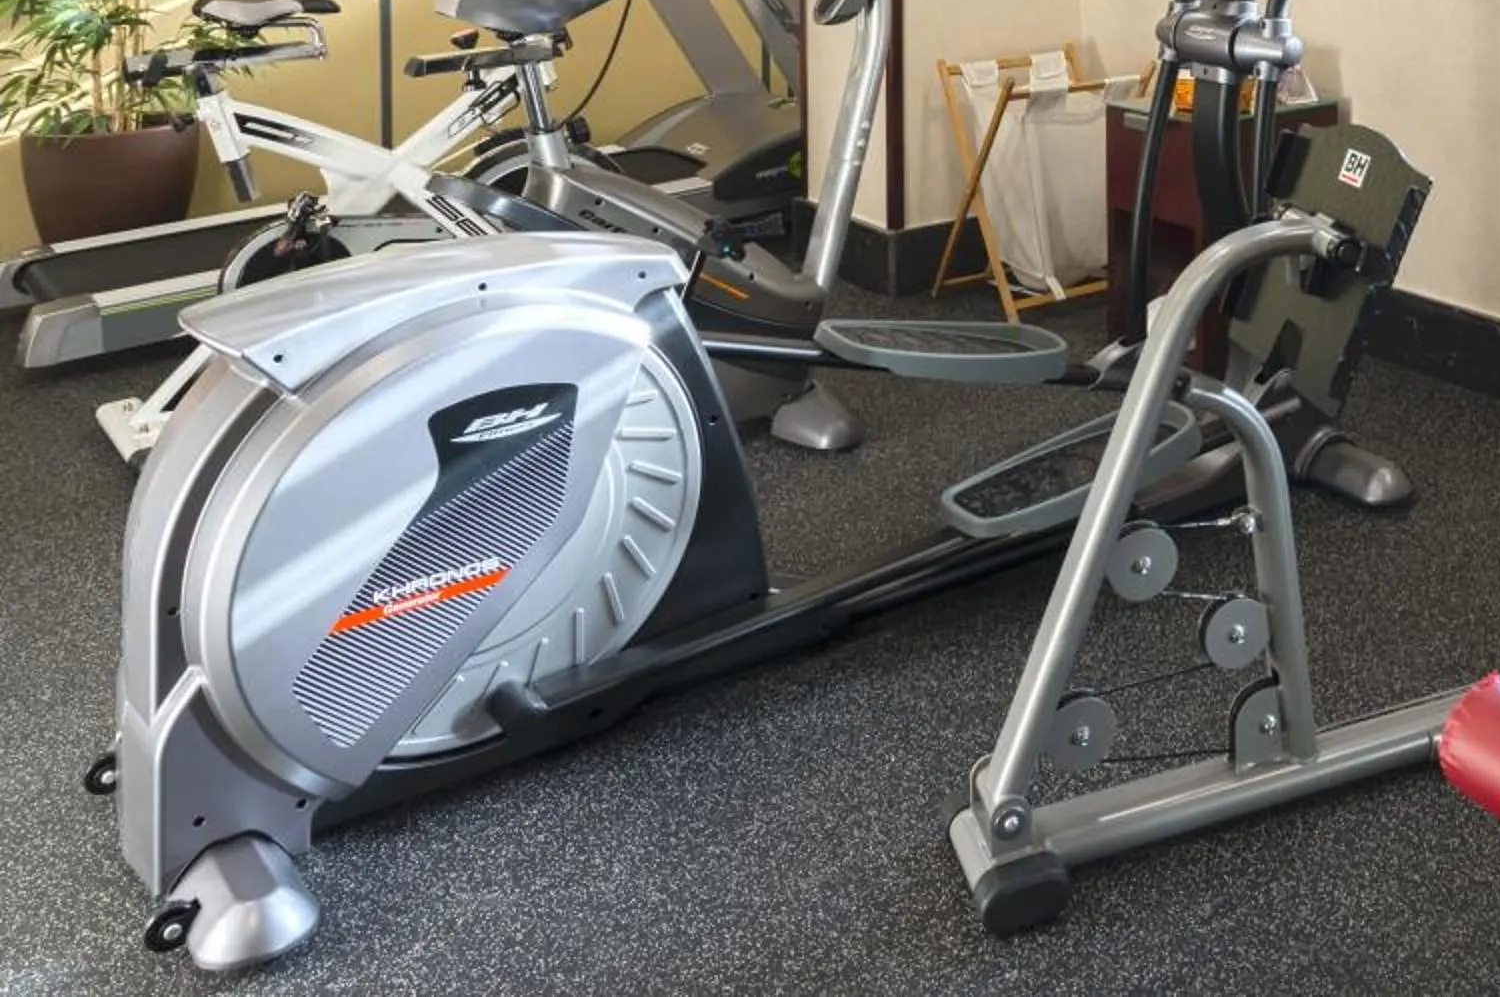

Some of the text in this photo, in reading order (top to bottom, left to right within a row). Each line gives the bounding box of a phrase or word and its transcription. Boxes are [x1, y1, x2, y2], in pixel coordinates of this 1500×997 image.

[1344, 152, 1369, 176] BH
[463, 402, 549, 435] BH
[373, 556, 501, 604] KHRONOS
